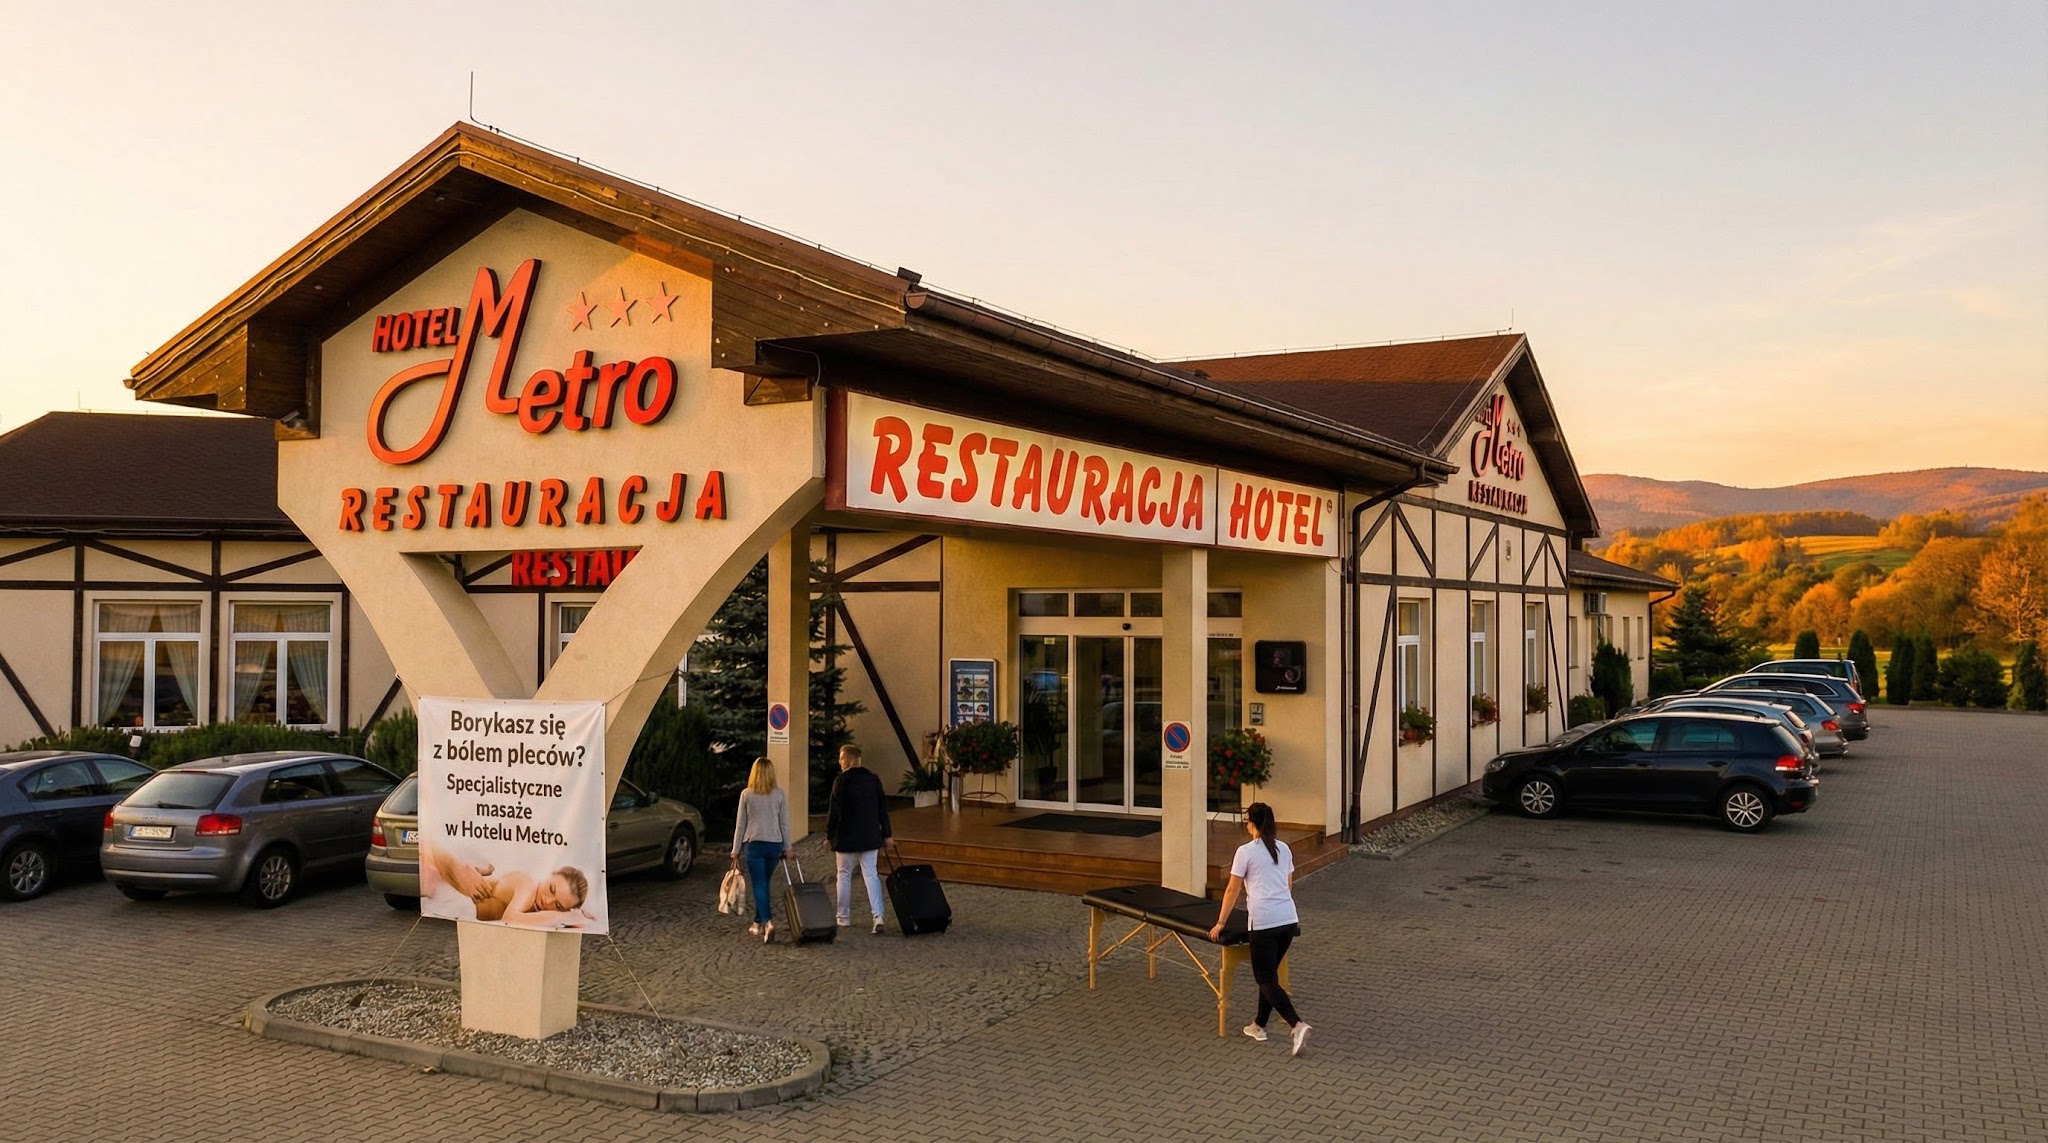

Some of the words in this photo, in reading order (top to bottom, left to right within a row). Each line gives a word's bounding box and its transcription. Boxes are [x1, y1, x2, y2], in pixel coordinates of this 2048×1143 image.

[372, 306, 461, 353] HOTEL
[366, 258, 678, 465] Metro
[1471, 393, 1525, 481] Metro
[868, 415, 1204, 530] RESTAURACJA
[1229, 482, 1325, 546] HOTEL
[339, 470, 727, 532] RESTAURACJA
[451, 710, 534, 737] Borykasz
[540, 714, 566, 740] się
[433, 744, 442, 759] z
[447, 739, 502, 763] bólem
[507, 743, 586, 767] pleców?
[447, 773, 562, 798] Specjalistyczne
[476, 802, 532, 819] masaże
[445, 823, 458, 836] w
[462, 821, 512, 842] Hotelu
[516, 826, 568, 846] Metro.
